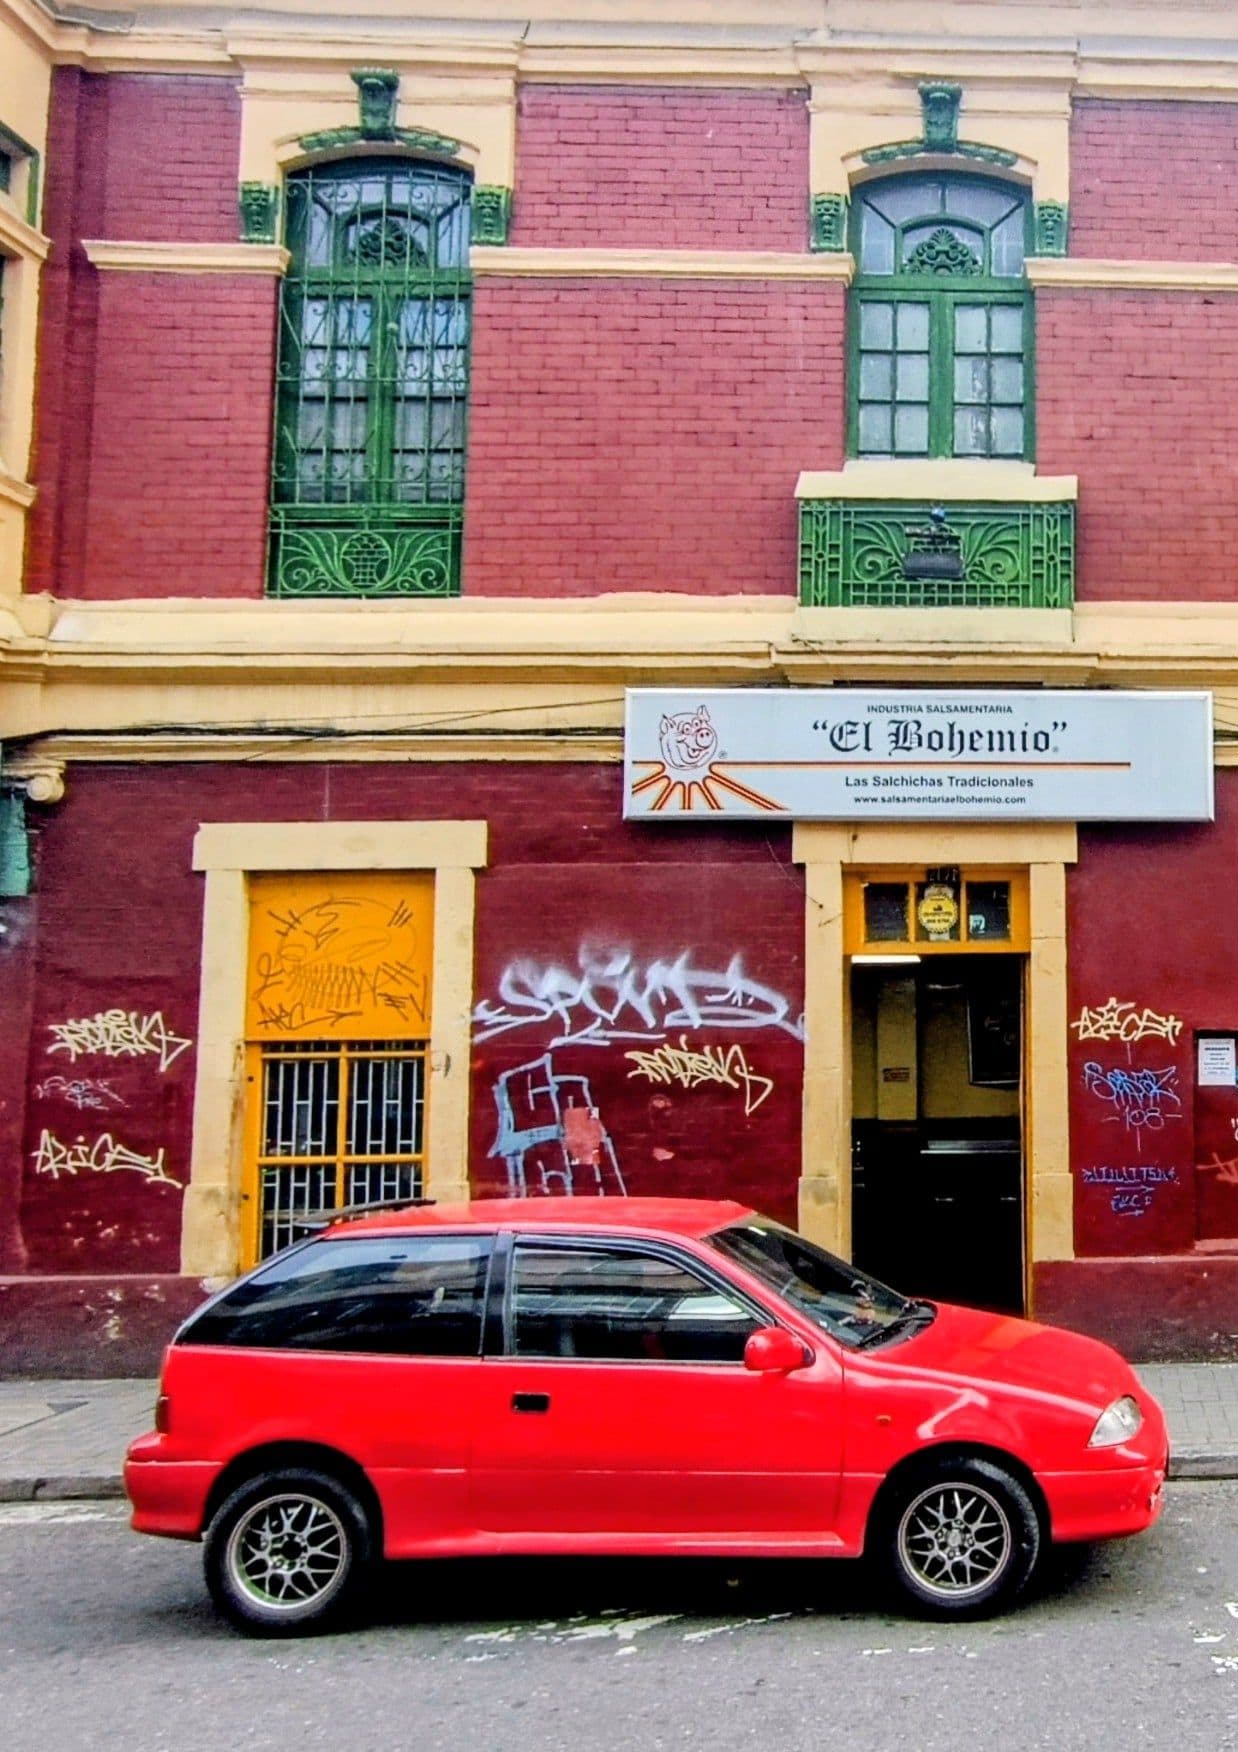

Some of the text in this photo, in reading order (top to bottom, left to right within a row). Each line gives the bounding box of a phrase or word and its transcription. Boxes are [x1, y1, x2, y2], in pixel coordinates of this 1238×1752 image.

[867, 704, 1013, 714] INDUSTRIA SALSAMENTARIA
[845, 776, 1034, 787] Las Salchichas Tradicionales
[854, 795, 1026, 805] www.salsamentariaelbohemio.com
